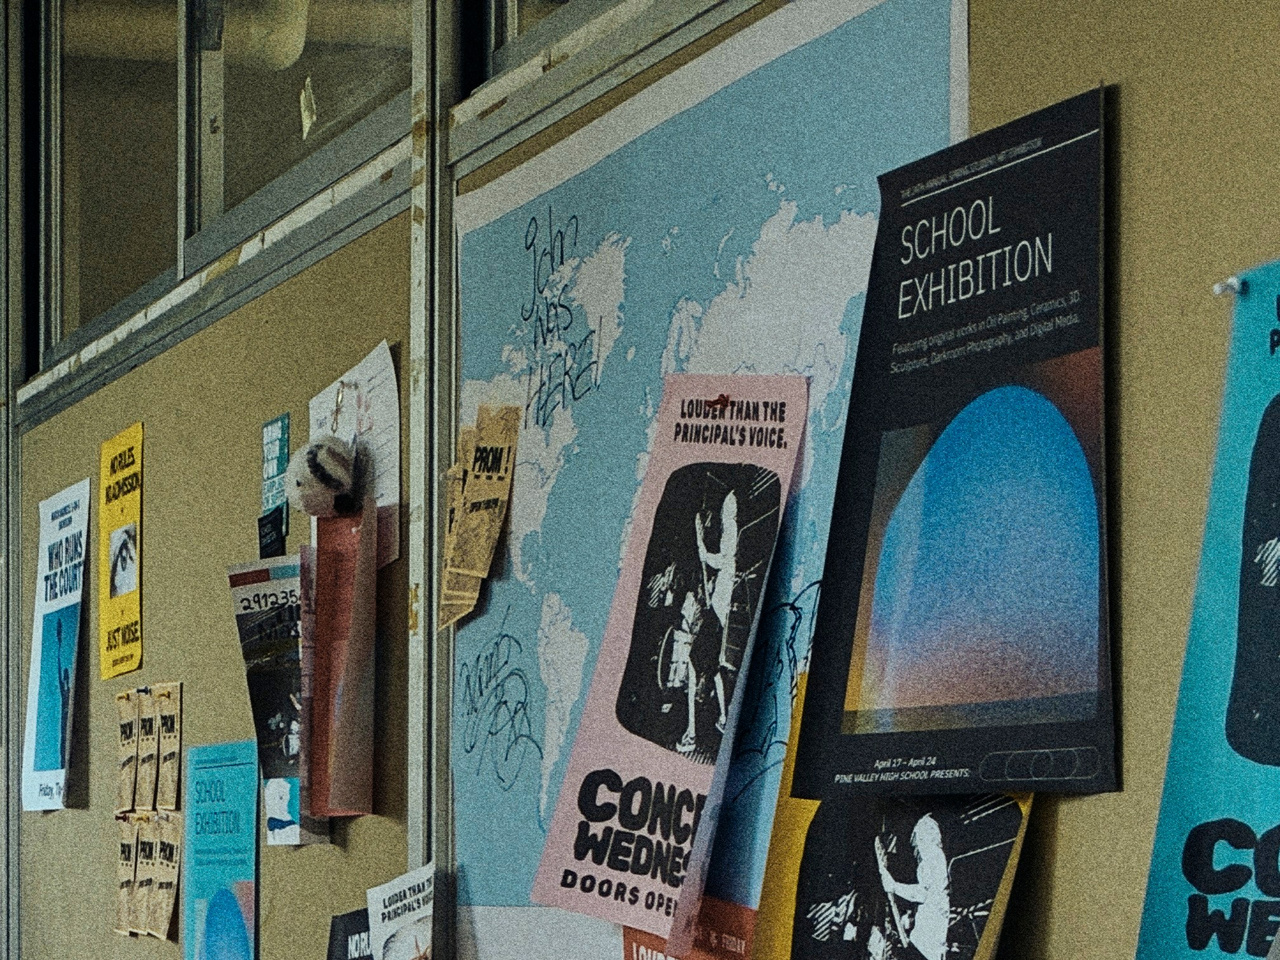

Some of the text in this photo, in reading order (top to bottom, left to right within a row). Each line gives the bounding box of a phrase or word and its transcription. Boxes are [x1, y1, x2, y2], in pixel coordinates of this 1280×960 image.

[900, 196, 1001, 266] SCHOOL
[897, 233, 1053, 320] EXHIBITION
[893, 336, 928, 355] Featuring
[928, 327, 956, 347] original
[1014, 325, 1028, 340] and
[1029, 318, 1055, 337] Digital
[730, 400, 760, 422] THAN
[763, 401, 786, 423] THE
[673, 422, 746, 447] PRINCIPAL'S
[472, 446, 503, 474] PROM
[48, 538, 63, 572] WHO
[44, 571, 58, 603] THE
[834, 773, 852, 783] PINE
[853, 772, 879, 783] VALLEY
[879, 771, 900, 782] HIGH
[900, 770, 928, 781] SCHOOL
[874, 758, 891, 770] April
[908, 757, 925, 768] April
[926, 756, 937, 766] 24
[195, 779, 226, 804] SCHOOL
[382, 888, 407, 910] LOUDER
[560, 869, 640, 906] DOORS
[381, 897, 421, 924] PRINCIPAL'S
[347, 933, 360, 960] NO
